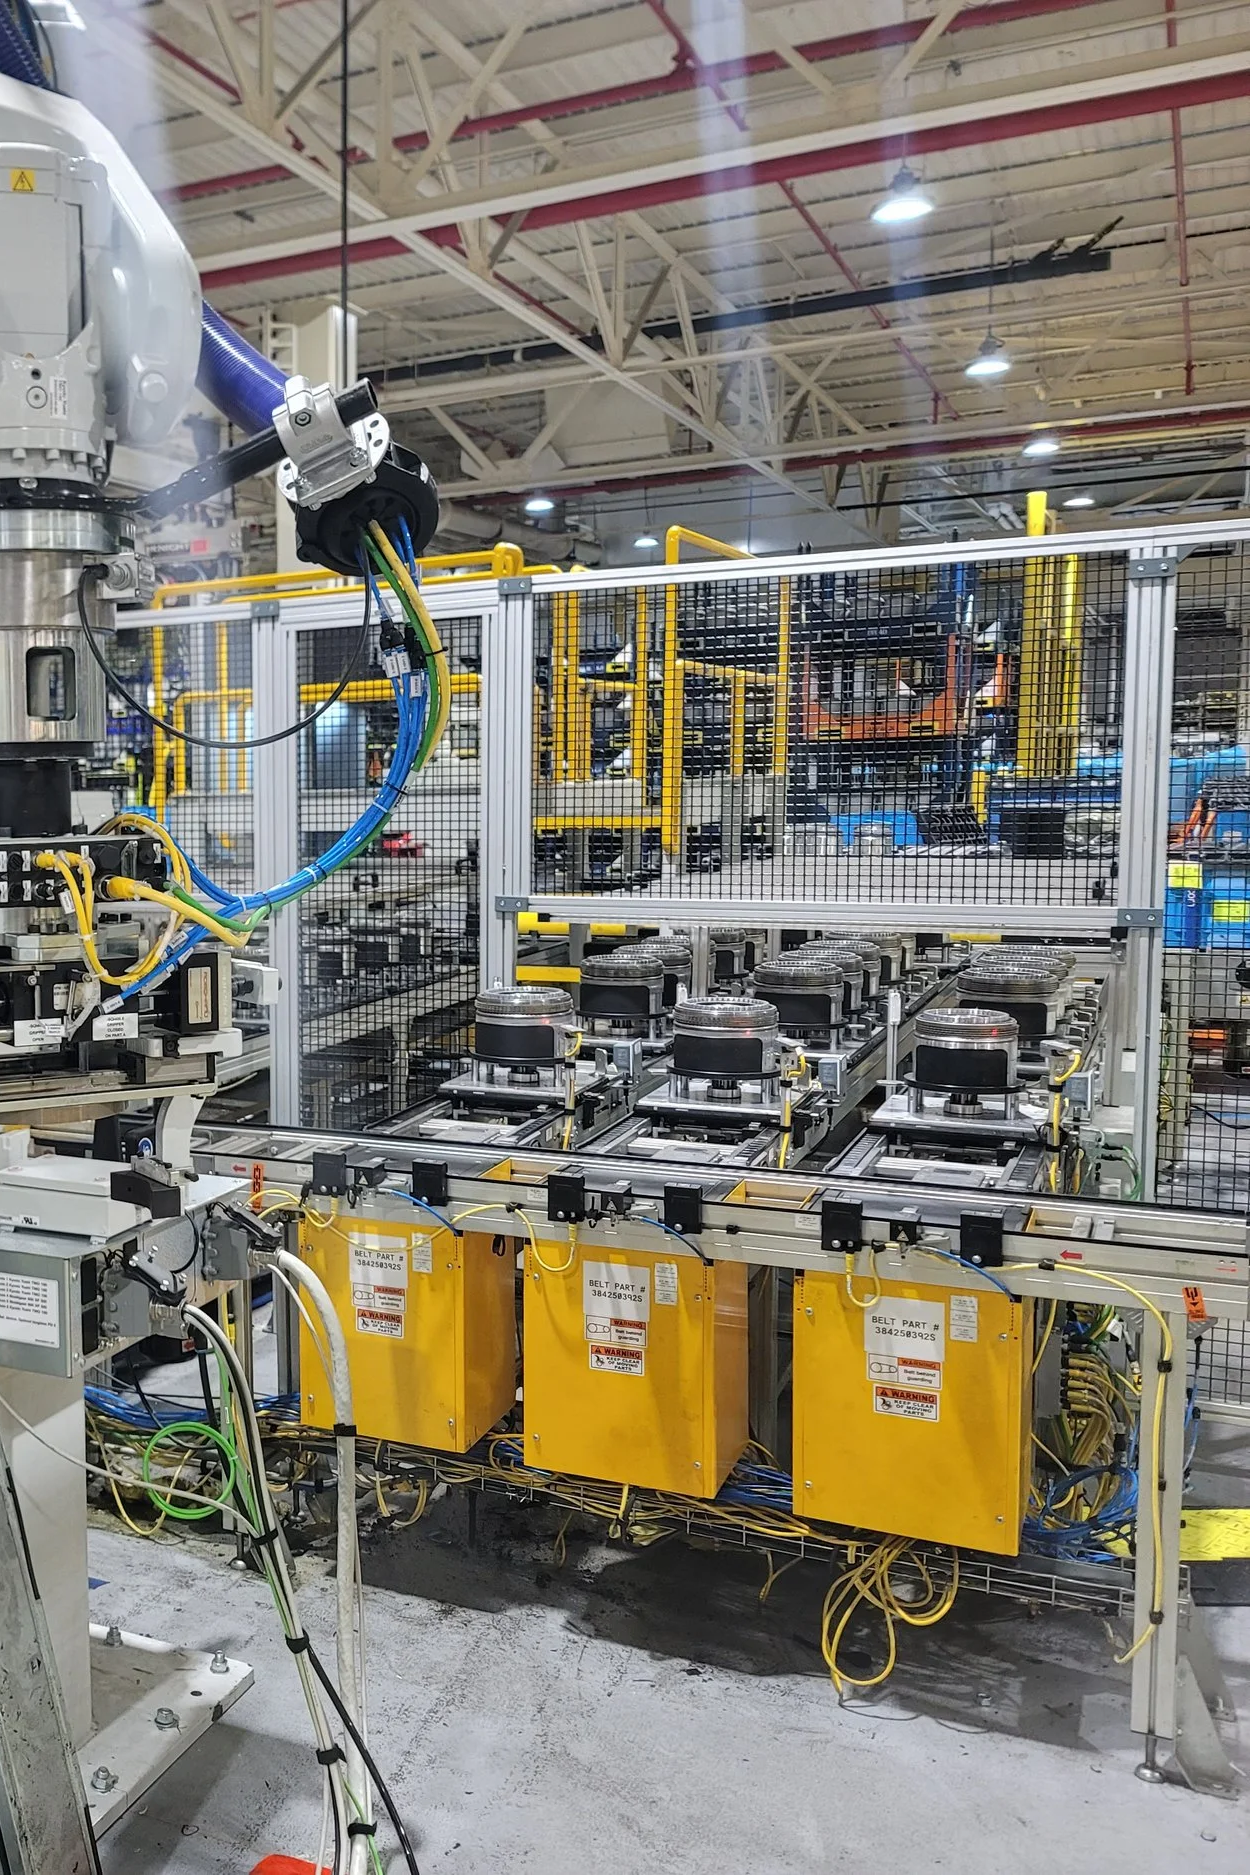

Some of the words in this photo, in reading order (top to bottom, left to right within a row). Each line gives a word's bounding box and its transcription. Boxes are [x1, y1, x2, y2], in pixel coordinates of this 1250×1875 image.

[355, 1250, 372, 1258] BELT
[377, 1253, 395, 1261] PART
[589, 1280, 610, 1288] BELT
[615, 1283, 635, 1292] PART
[369, 1312, 401, 1323] WARNING
[872, 1316, 896, 1326] BELT
[903, 1320, 927, 1329] PART
[614, 1320, 642, 1328] WARNING
[605, 1348, 640, 1358] WARNING
[902, 1360, 936, 1369] WARNING
[892, 1391, 935, 1403] WARNING
